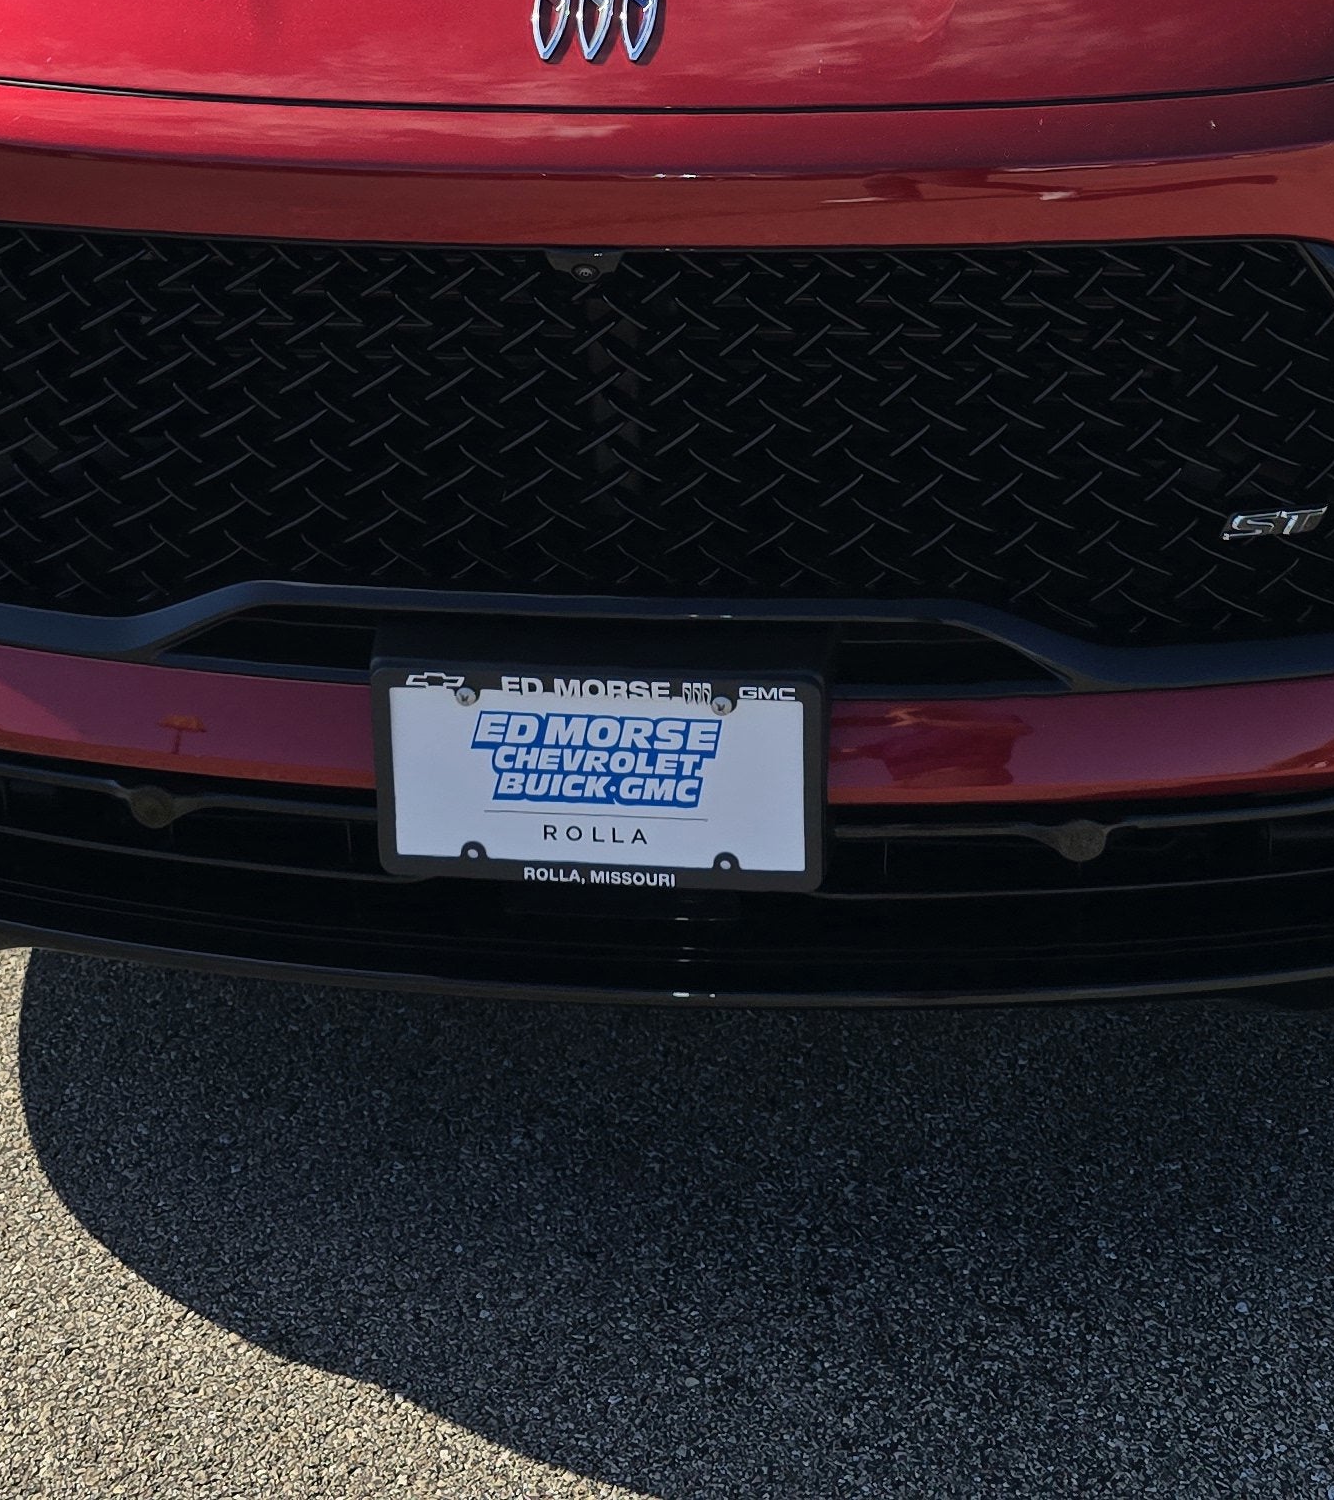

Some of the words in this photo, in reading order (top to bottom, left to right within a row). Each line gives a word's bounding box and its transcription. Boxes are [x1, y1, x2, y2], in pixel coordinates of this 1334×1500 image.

[501, 676, 544, 696] ED
[553, 678, 670, 700] MORSE
[739, 686, 796, 700] GMC
[474, 713, 539, 744] ED
[543, 715, 719, 751] MORSE
[494, 746, 701, 776] CHEVROLET
[543, 824, 648, 845] ROLLA
[523, 866, 586, 885] ROLLA,
[590, 870, 676, 888] MISSOURI
